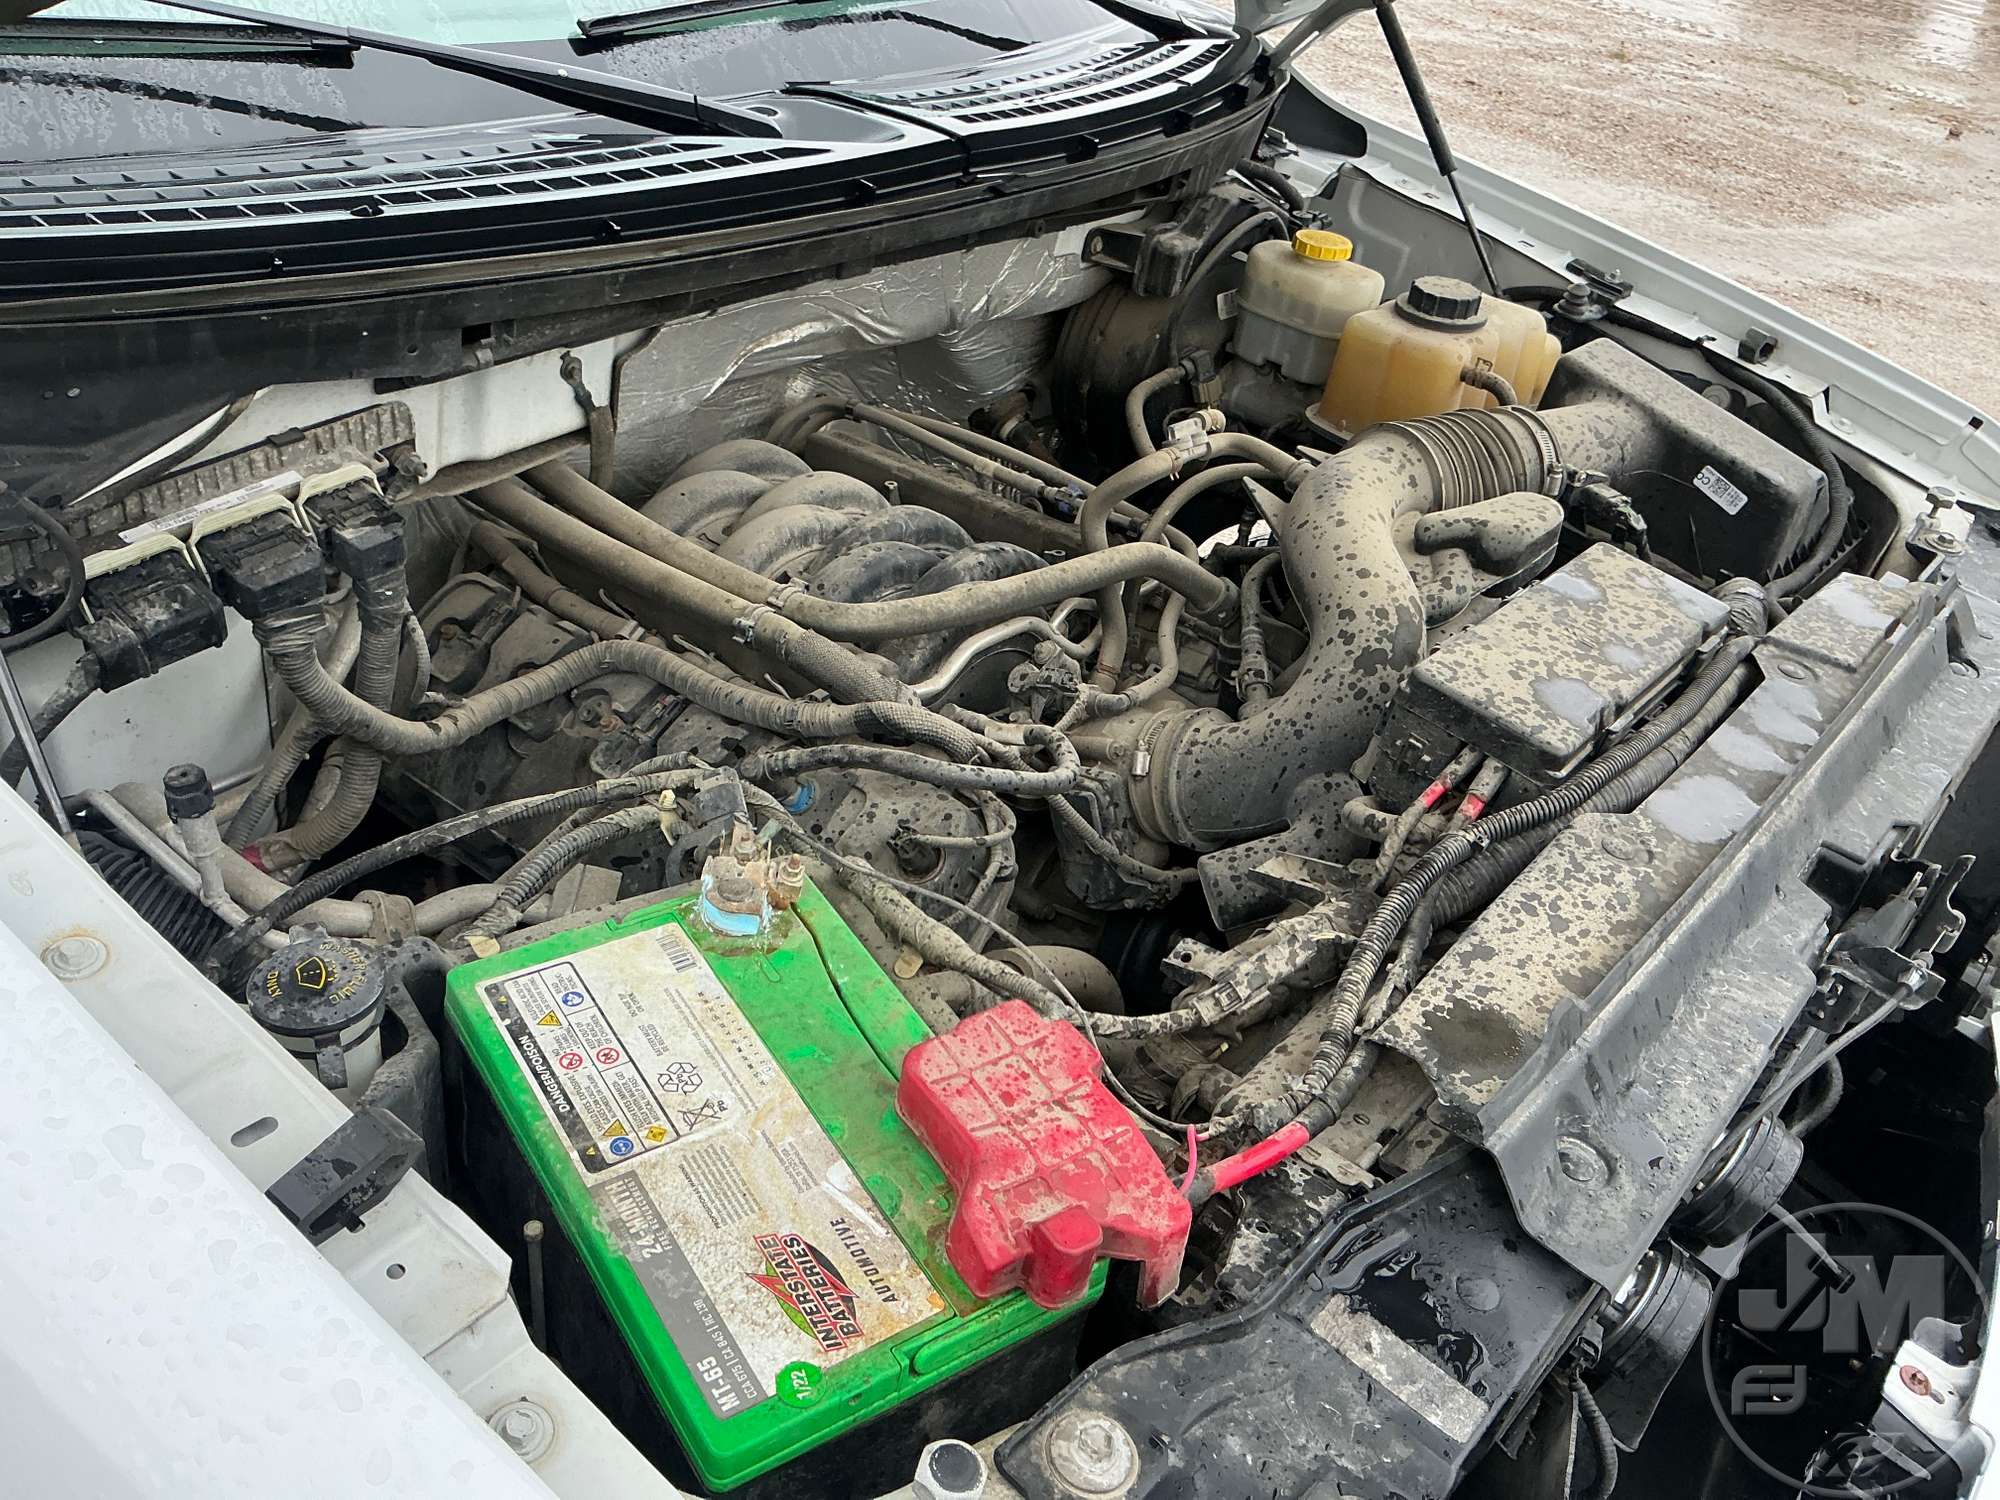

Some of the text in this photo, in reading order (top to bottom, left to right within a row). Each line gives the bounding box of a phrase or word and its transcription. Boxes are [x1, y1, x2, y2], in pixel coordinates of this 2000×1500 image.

[267, 969, 283, 998] ONLY
[320, 943, 368, 1004] WASHER FLUID
[574, 1020, 596, 1049] KEEP OUT OF
[593, 1036, 604, 1047] THE
[603, 1036, 612, 1044] OF
[551, 1047, 561, 1057] NO
[518, 1034, 570, 1113] DANGER/POISON
[567, 1074, 587, 1101] EXPLOSIVE
[615, 1070, 625, 1080] GET
[674, 1072, 687, 1083] Pb
[622, 1099, 635, 1113] EYES
[634, 1086, 648, 1100] HELP
[714, 1099, 728, 1112] Pb
[603, 1179, 664, 1259] 24-MONTH
[623, 1175, 673, 1251] FREE REPLACEMENT
[827, 1215, 899, 1305] AUTOMOTIVE
[758, 1234, 843, 1351] INTERSTATE
[781, 1233, 860, 1338] BATTERIES
[692, 1297, 758, 1399] CCA 675 CA 845 RC 130
[695, 1354, 741, 1412] MT-65
[791, 1368, 812, 1400] 1/22
